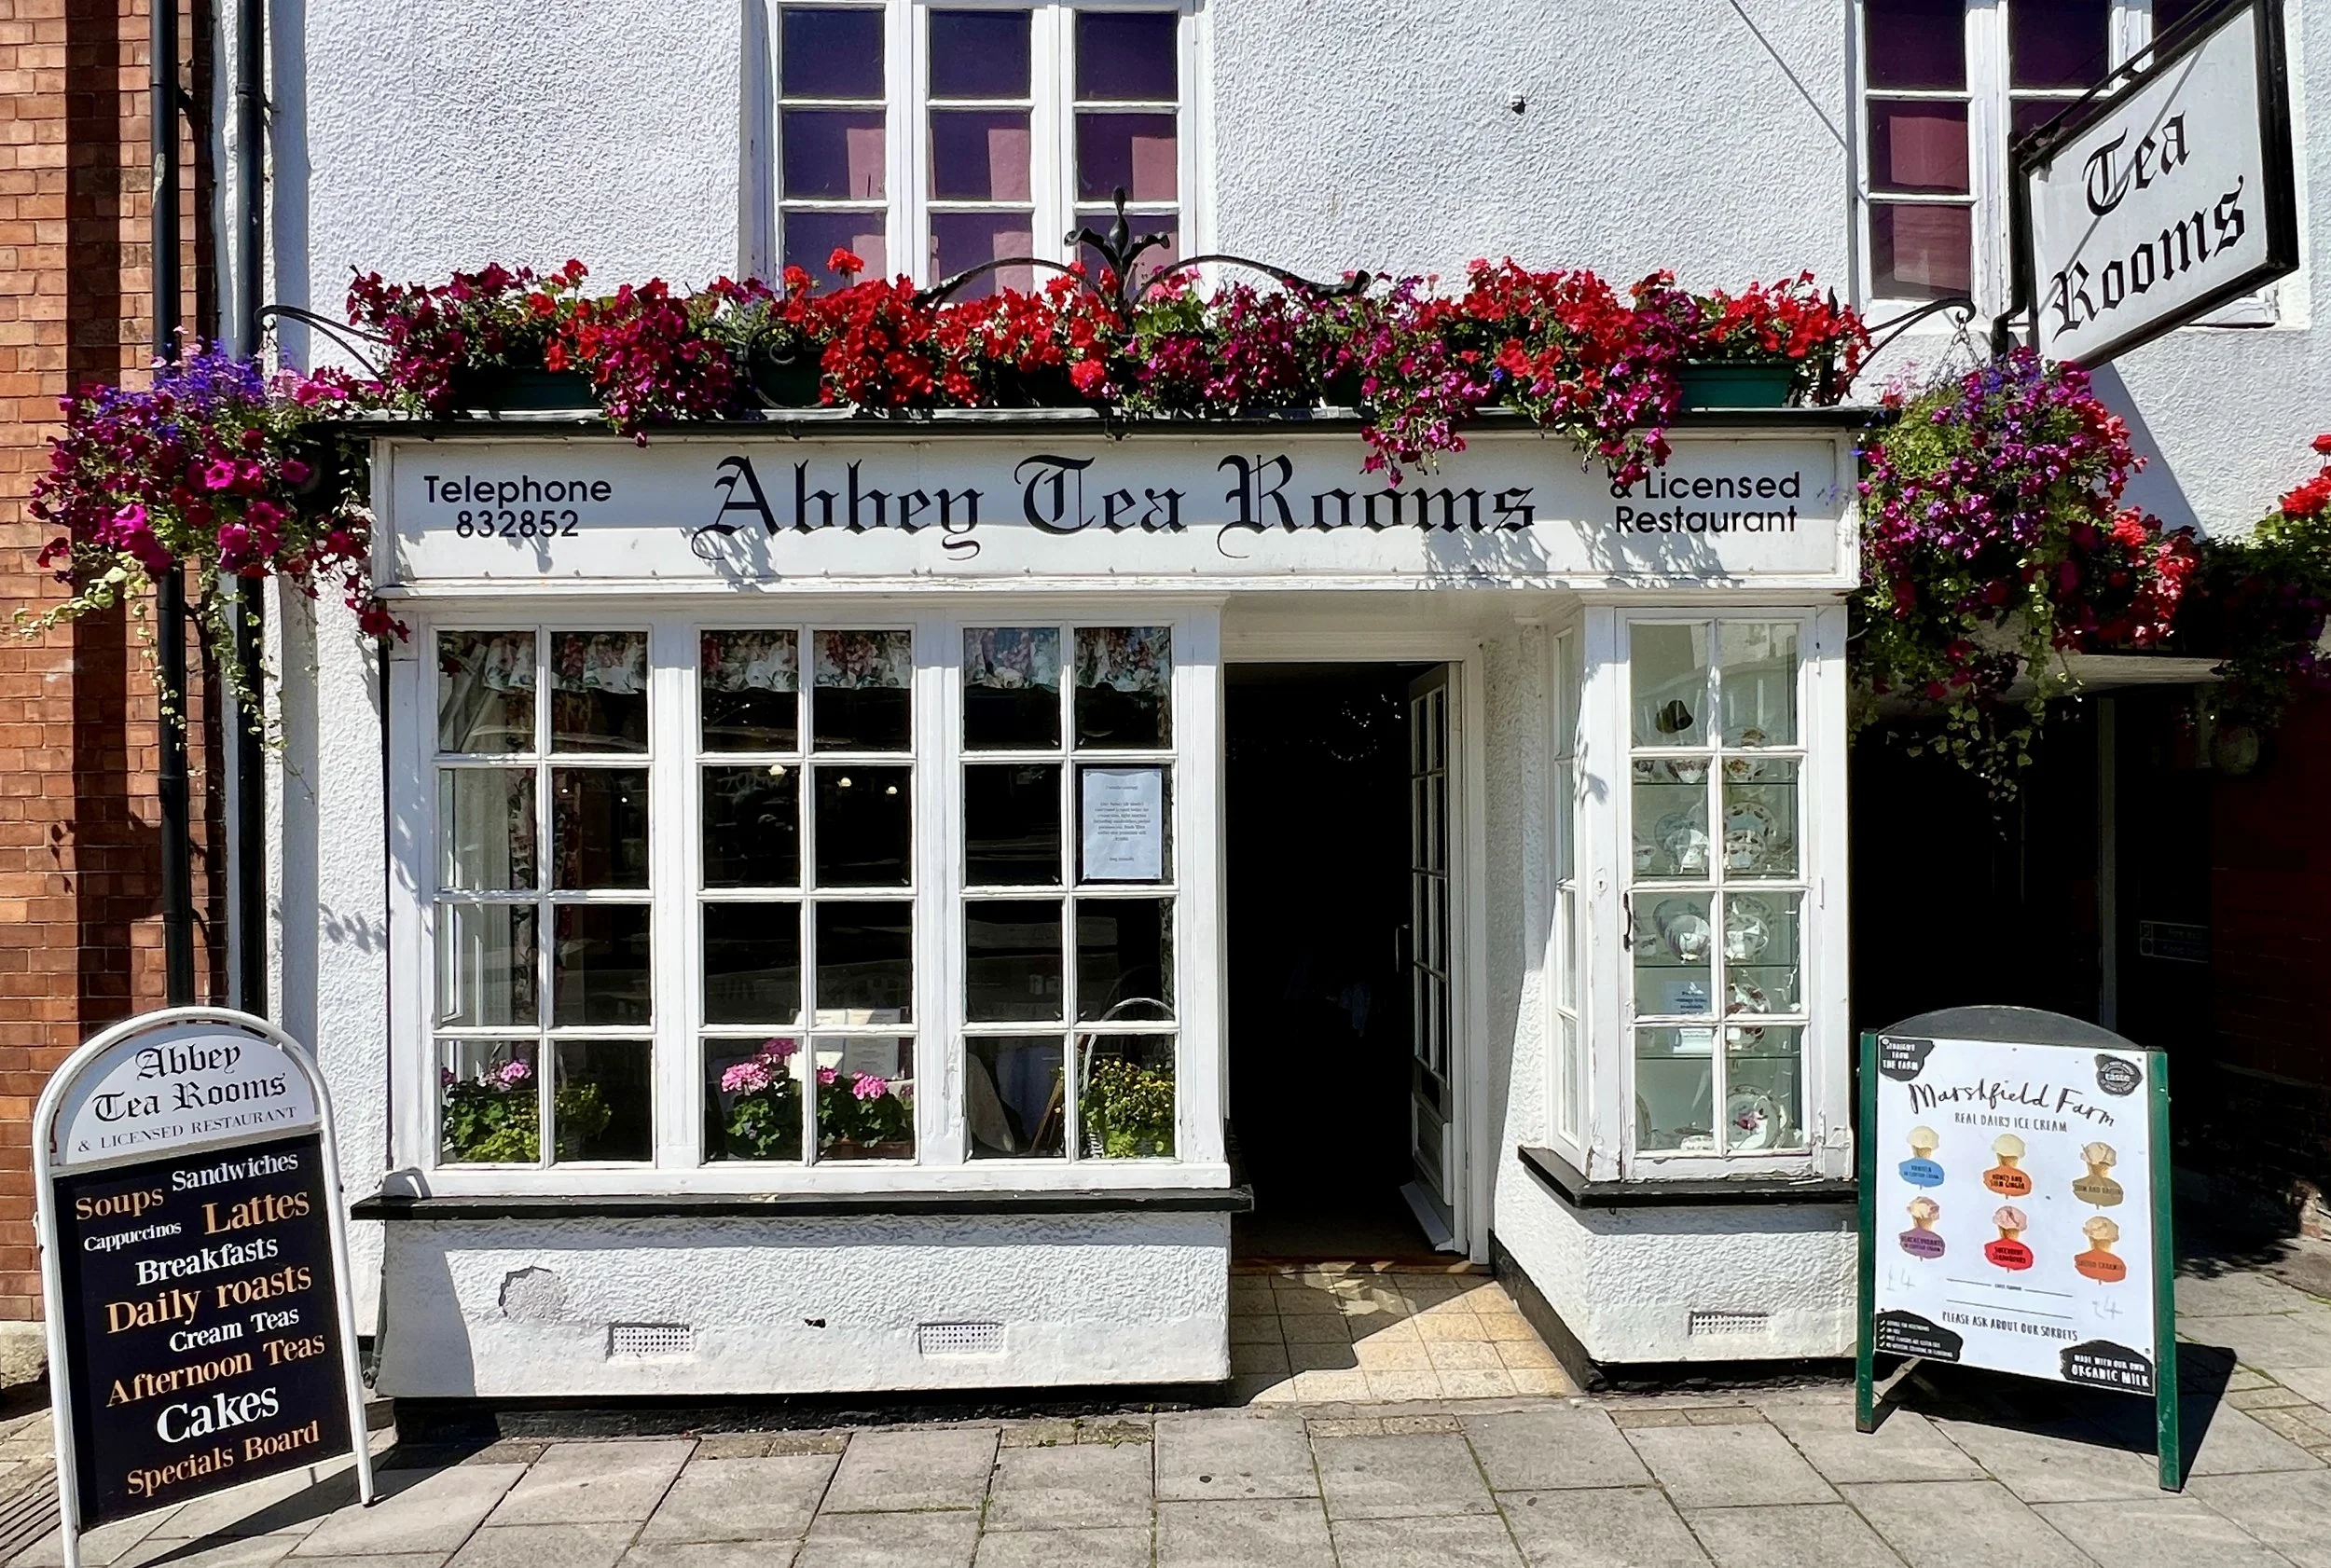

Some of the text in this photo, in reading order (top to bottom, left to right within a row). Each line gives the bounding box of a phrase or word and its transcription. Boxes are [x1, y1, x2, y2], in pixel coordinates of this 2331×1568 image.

[2081, 110, 2190, 216] Tea
[2050, 174, 2245, 343] Rooms
[423, 475, 612, 508] Telephone
[691, 454, 1536, 561] Abbey Tea Rooms
[1644, 471, 1800, 499] Licensed
[455, 510, 579, 538] 832852
[1616, 505, 1797, 533] Restaurant
[134, 1043, 241, 1080] Abbey
[91, 1072, 287, 1122] Tea Rooms
[1908, 1078, 2116, 1127] Marshfield Farm
[77, 1107, 297, 1152] & LICENSED RESTAURANT
[1954, 1112, 2068, 1133] REAL DAIRY ICE CREAM
[172, 1153, 298, 1192] Sandwiches
[76, 1188, 164, 1220] Soups
[201, 1190, 310, 1236] Lattes
[84, 1222, 182, 1252] Cappuccinos
[135, 1237, 279, 1286] Breakfasts
[105, 1266, 311, 1334] Daily roasts
[169, 1308, 300, 1353] Cream Teas
[1942, 1311, 2078, 1342] PLEASE ASK ABOUT OUR SORBETS
[105, 1334, 325, 1408] Afternoon Teas
[2071, 1364, 2150, 1388] ORGANIC MILK
[157, 1386, 280, 1443] Cakes
[127, 1420, 320, 1497] Specials Board
